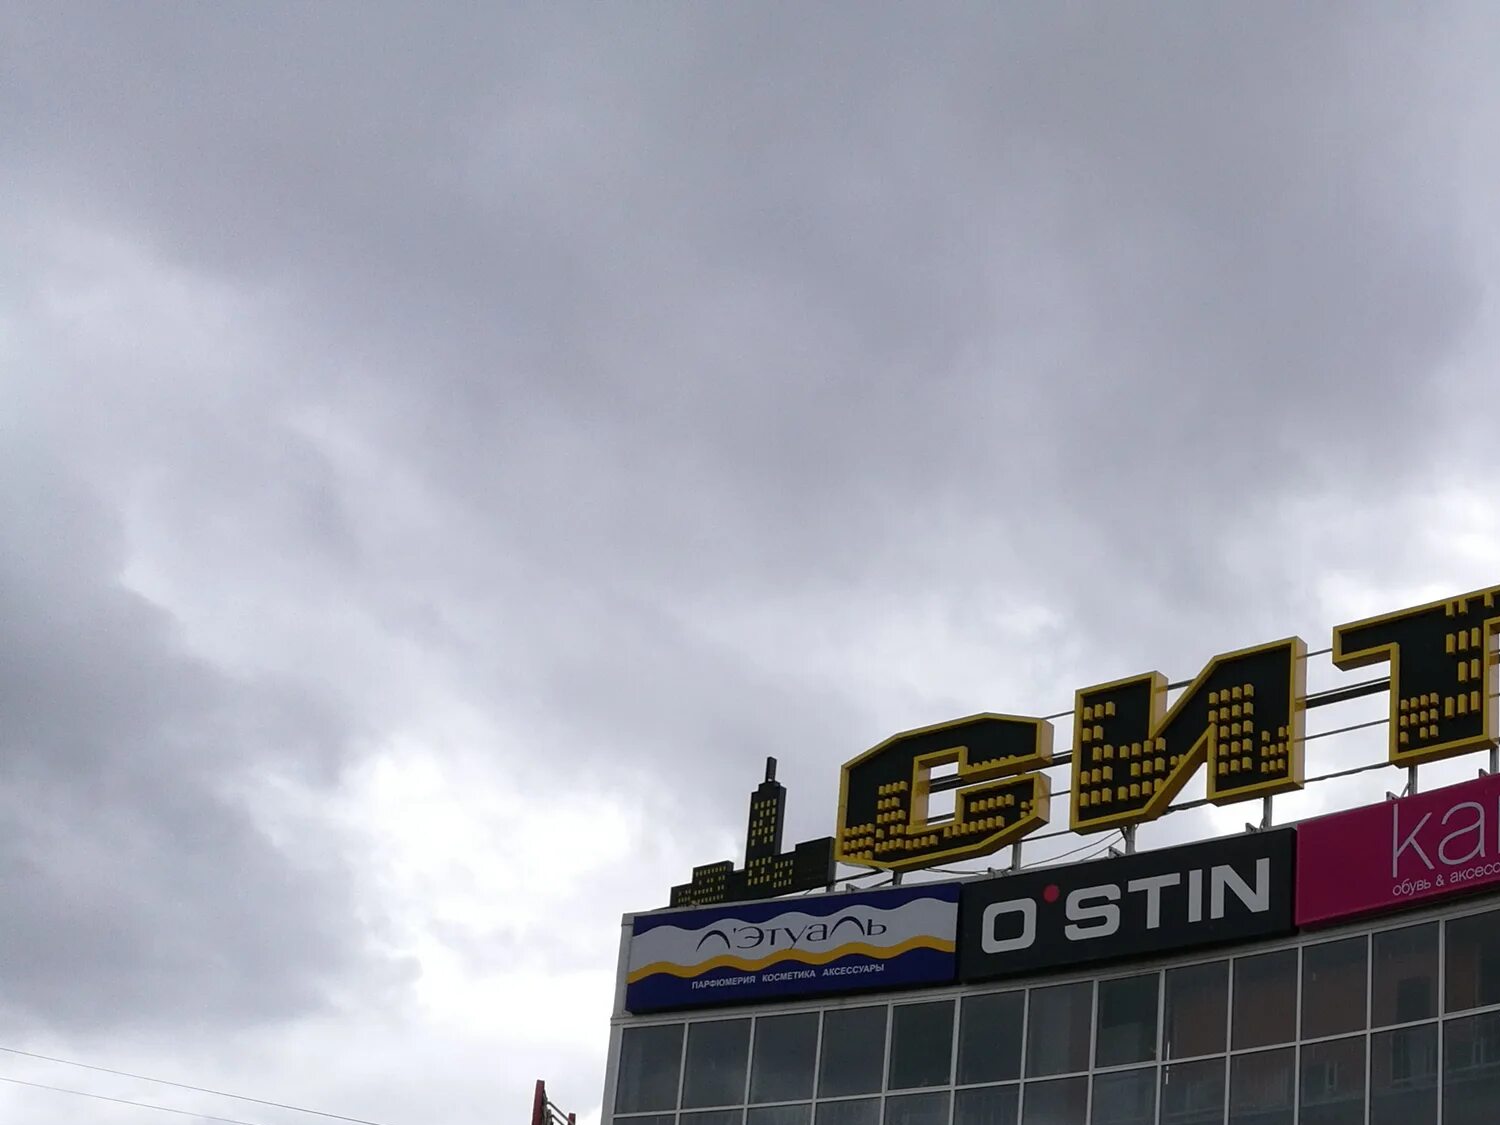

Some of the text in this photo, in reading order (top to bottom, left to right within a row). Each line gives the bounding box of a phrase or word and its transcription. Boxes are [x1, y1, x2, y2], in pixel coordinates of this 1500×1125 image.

[1392, 877, 1432, 896] обувь
[1435, 873, 1445, 887] &
[691, 963, 885, 990] ПАРФЮМЕРИЯ КОСМЕТИКА АКСЕССУАРЫ
